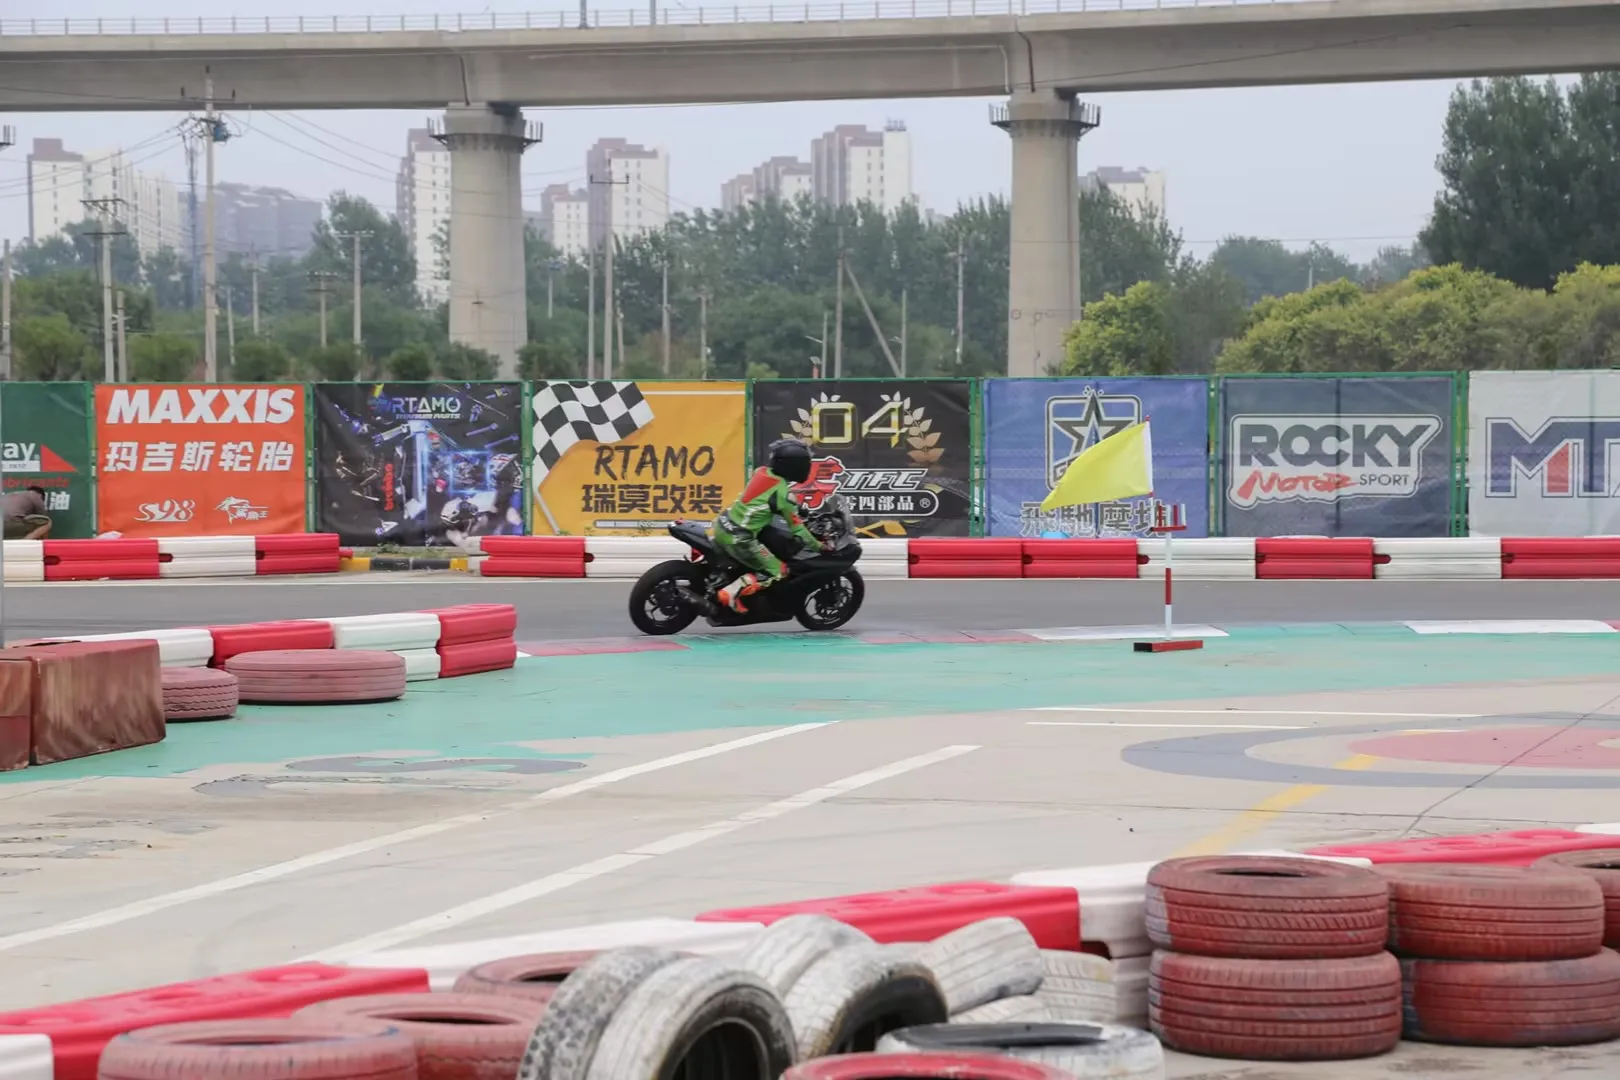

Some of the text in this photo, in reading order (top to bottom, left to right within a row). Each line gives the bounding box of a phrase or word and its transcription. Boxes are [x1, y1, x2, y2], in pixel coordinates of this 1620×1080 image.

[106, 389, 295, 424] MAXXIS
[392, 396, 460, 413] RTAMO
[812, 402, 908, 448] 04
[1, 442, 36, 461] ay
[103, 442, 294, 472] 玛吉斯轮胎
[1240, 424, 1431, 467] ROCKY
[594, 445, 715, 481] RTAMO
[1359, 474, 1409, 486] SPORT
[581, 484, 723, 514] 瑞莫改装
